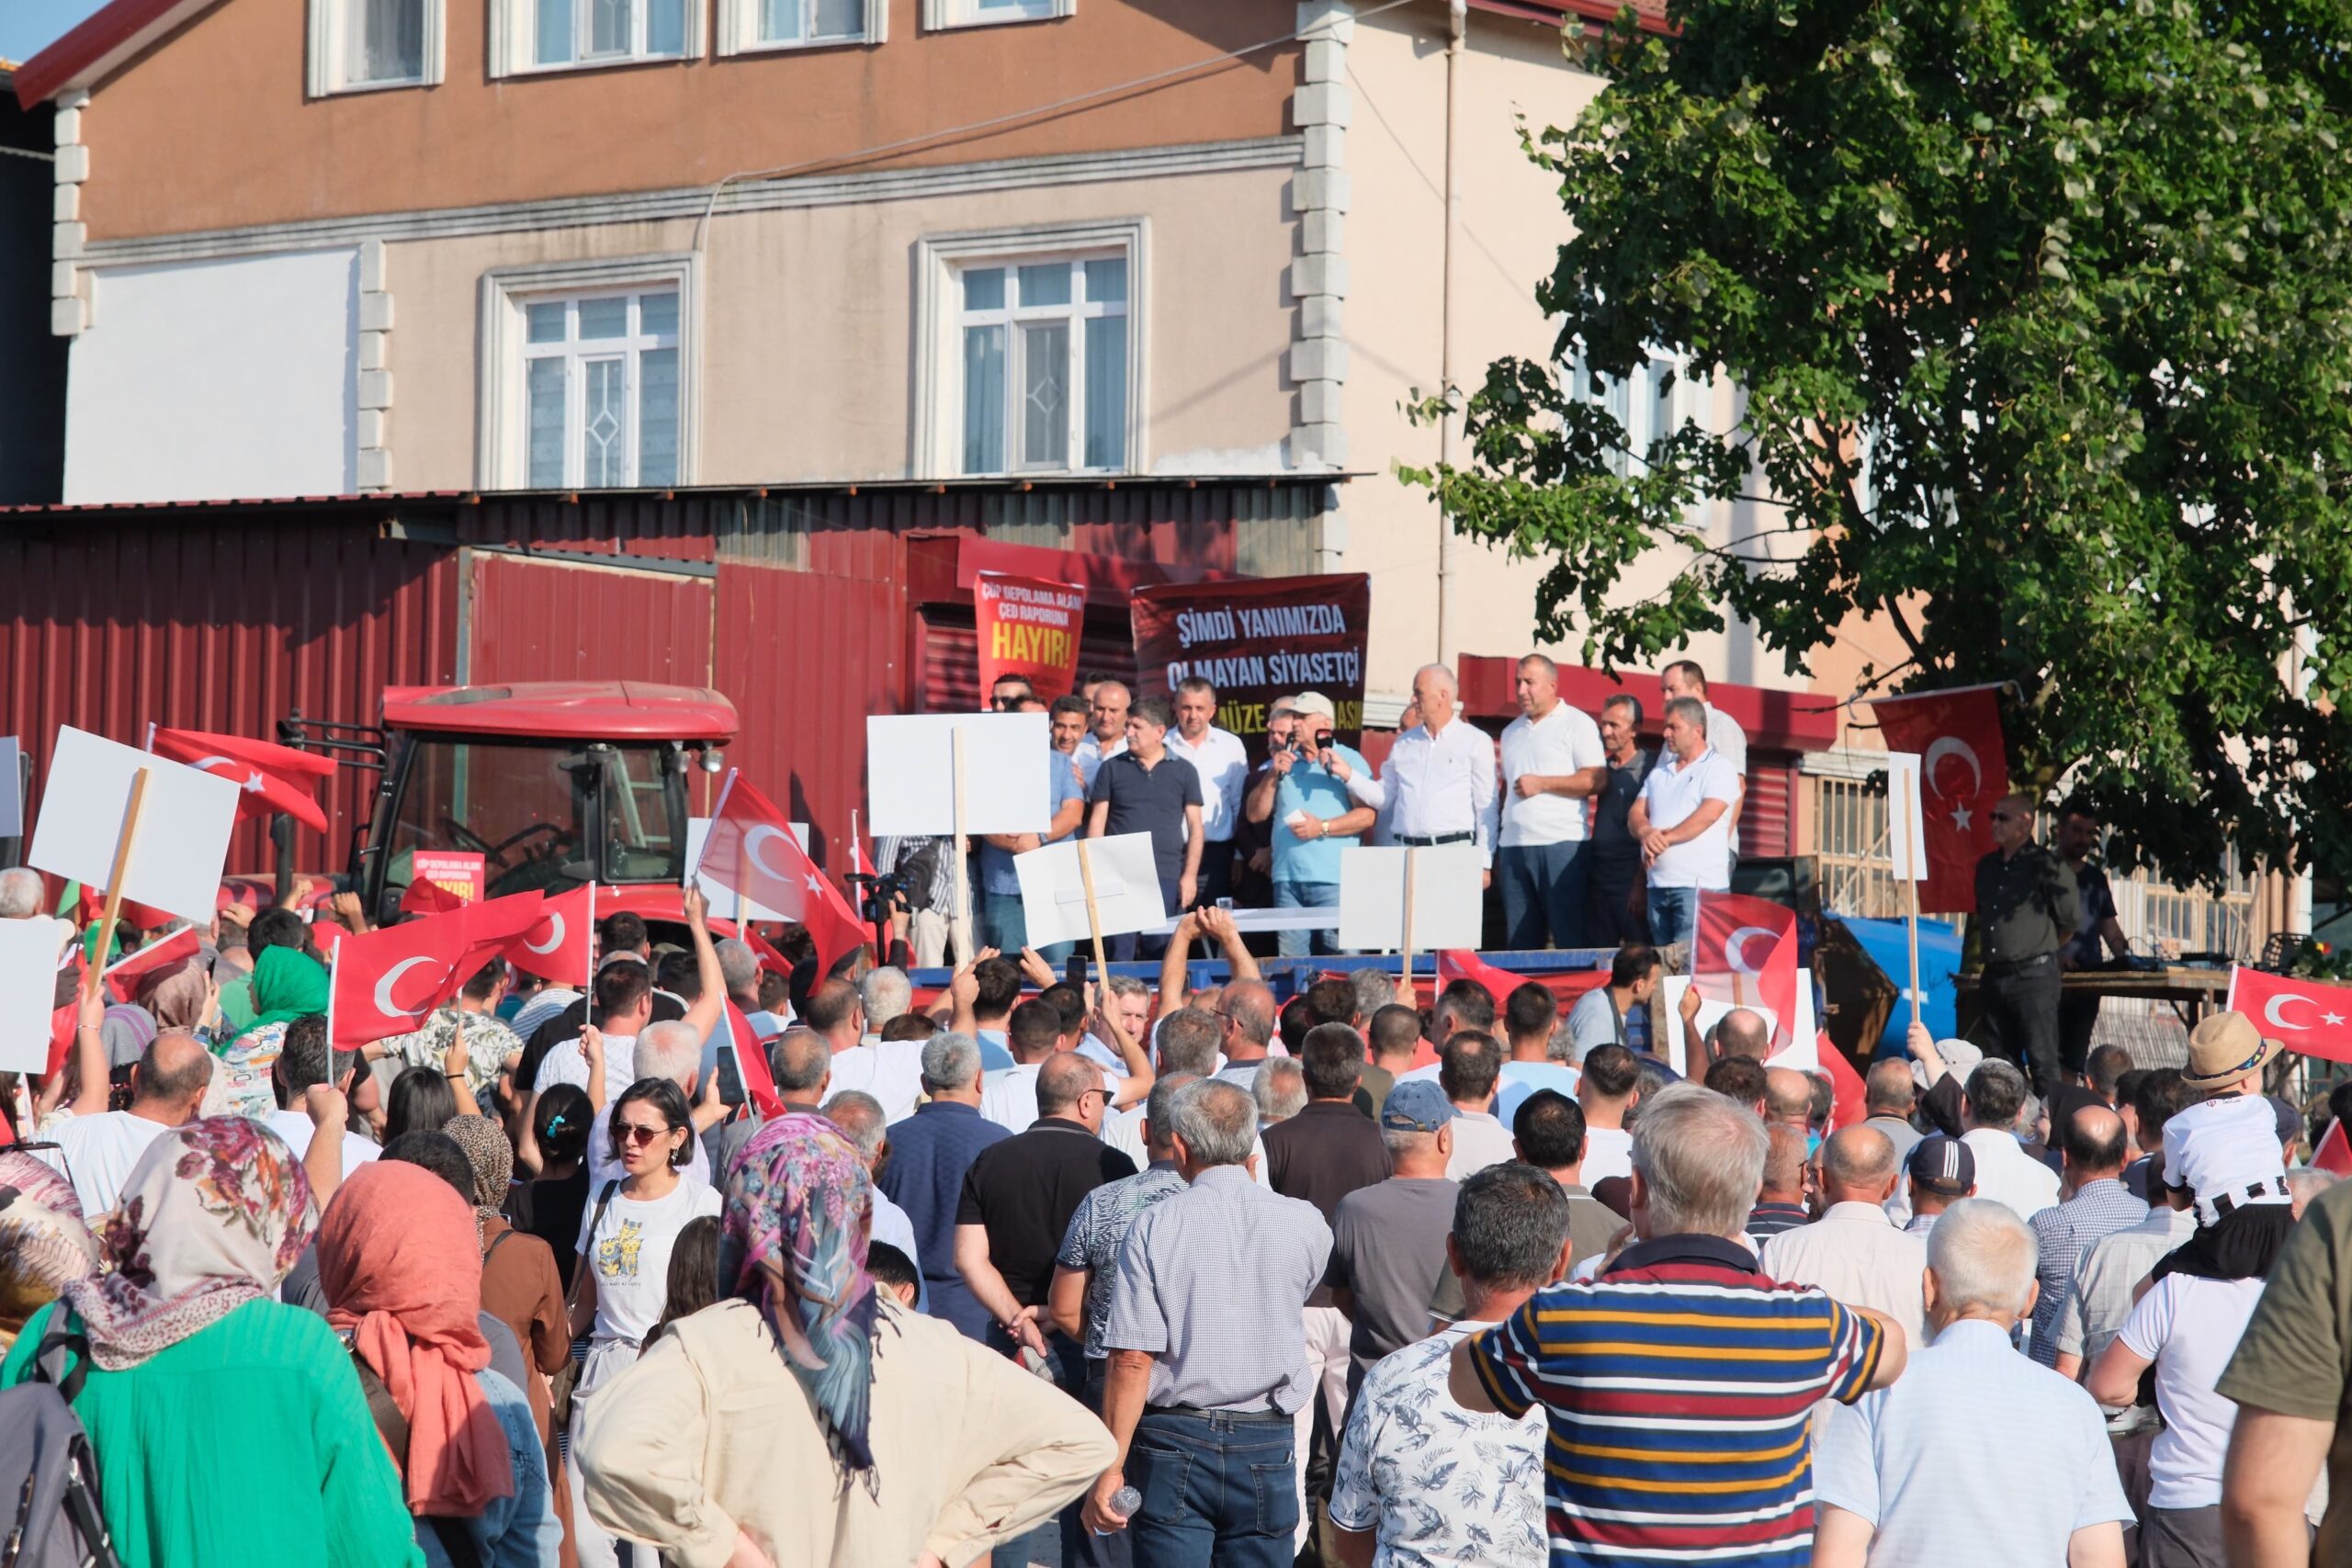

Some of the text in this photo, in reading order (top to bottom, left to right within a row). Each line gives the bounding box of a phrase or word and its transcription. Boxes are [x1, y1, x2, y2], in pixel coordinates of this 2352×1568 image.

[1003, 585, 1055, 605] DEPOLAMA
[992, 621, 1071, 670] HAYIR!
[1177, 604, 1346, 649] ŞİMDİ YANIMIZDA
[1269, 646, 1360, 688] SİYASETÇİ
